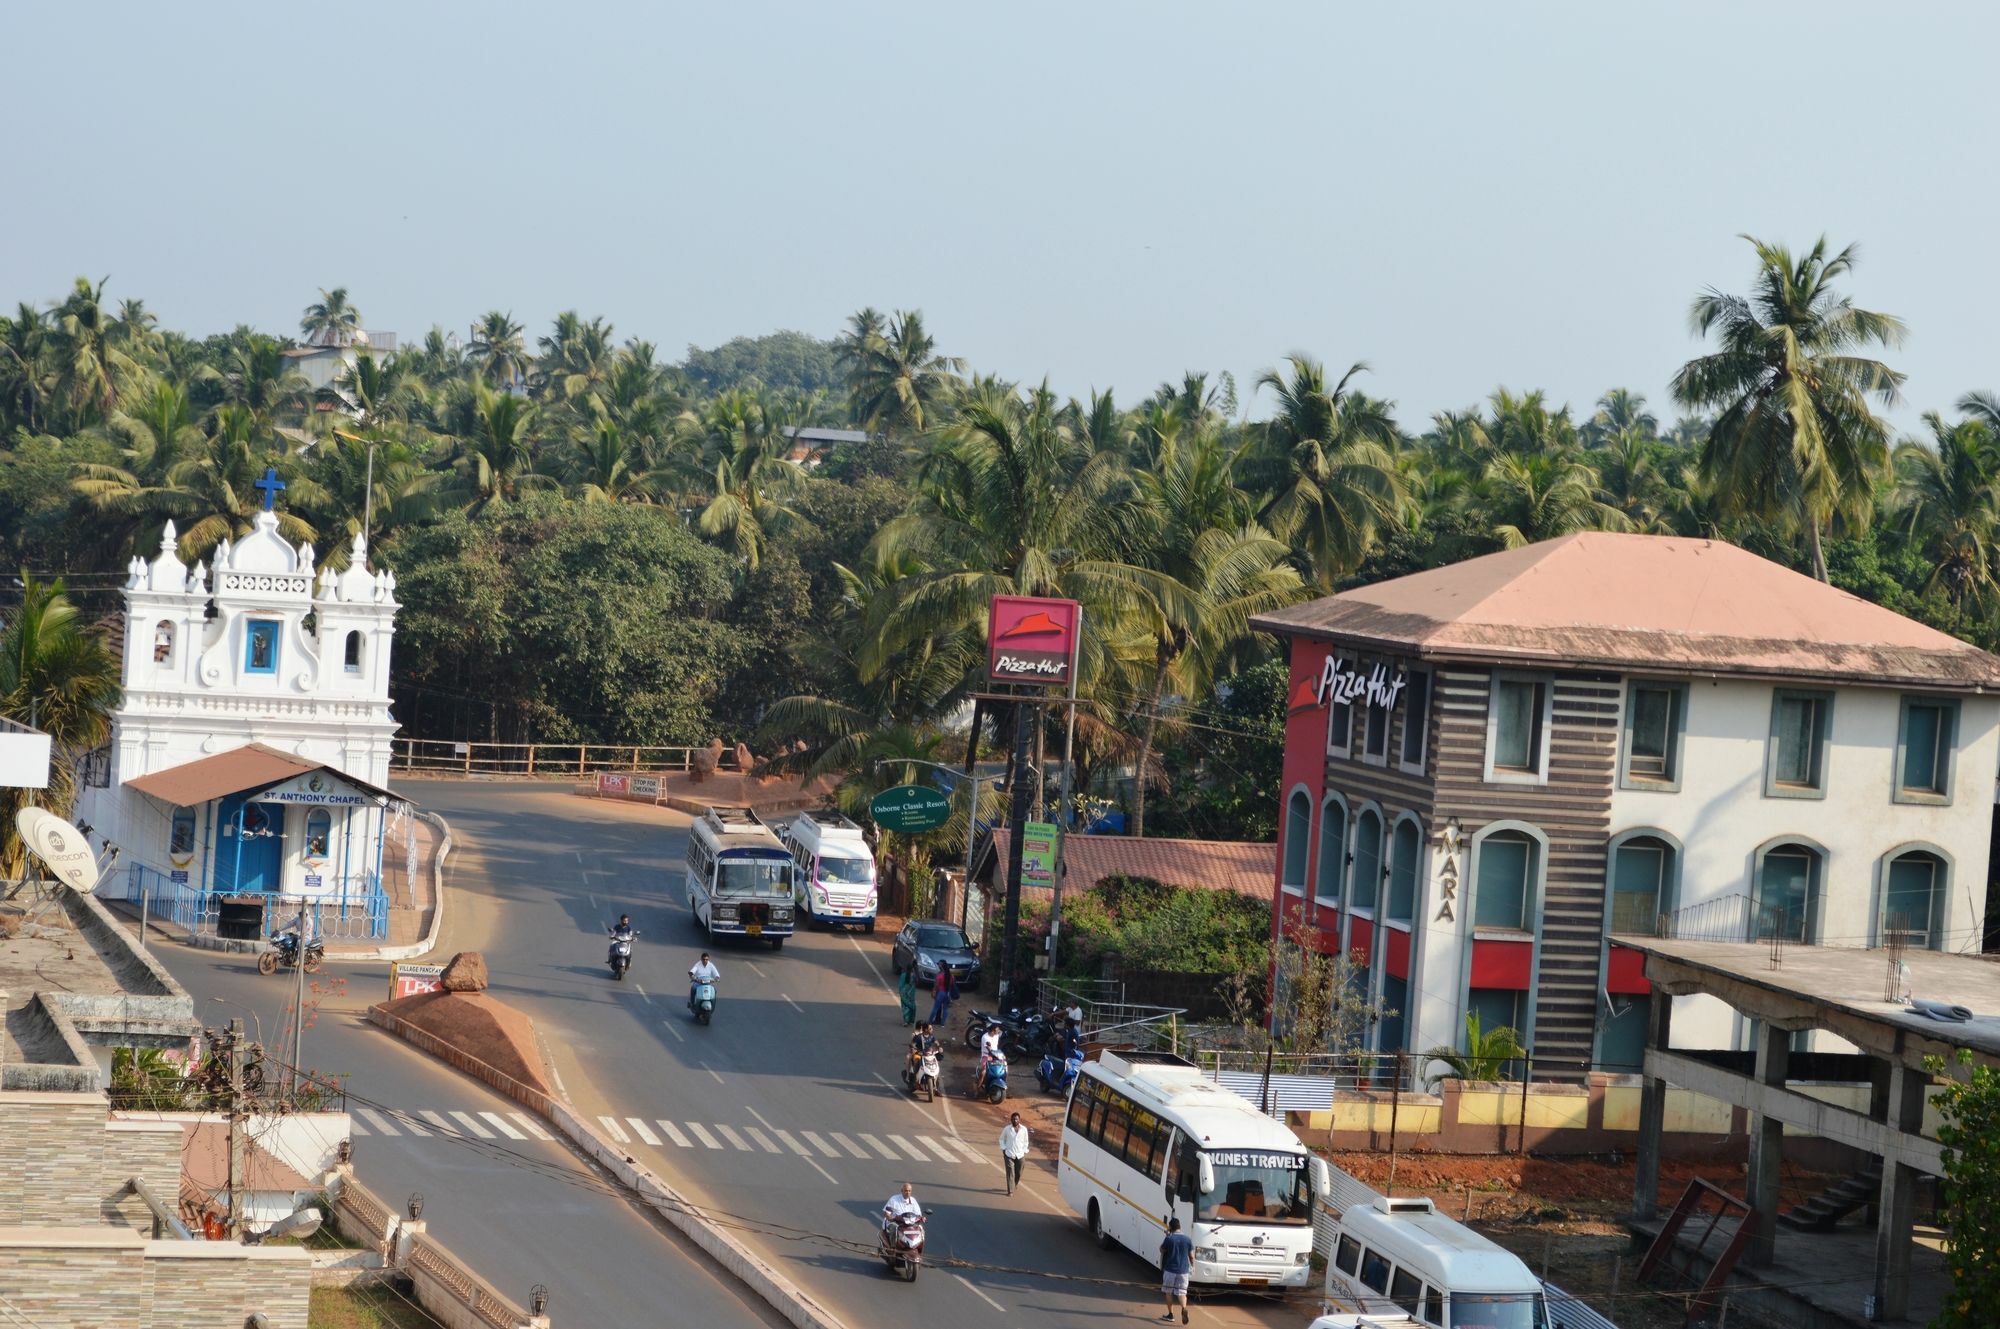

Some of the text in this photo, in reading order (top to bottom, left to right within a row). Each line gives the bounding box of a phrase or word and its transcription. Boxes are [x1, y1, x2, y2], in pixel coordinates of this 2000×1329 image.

[995, 655, 1068, 674] Pizza Hut
[1318, 655, 1406, 712] Pizza Hut
[604, 776, 622, 785] LPK
[263, 792, 366, 805] ST. ANTHONY CHAPEL
[874, 801, 947, 813] Osborne Classic Resort
[1434, 816, 1462, 922] AMARA
[404, 980, 437, 993] LPK
[1206, 1152, 1305, 1170] NUNES TRAVELS
